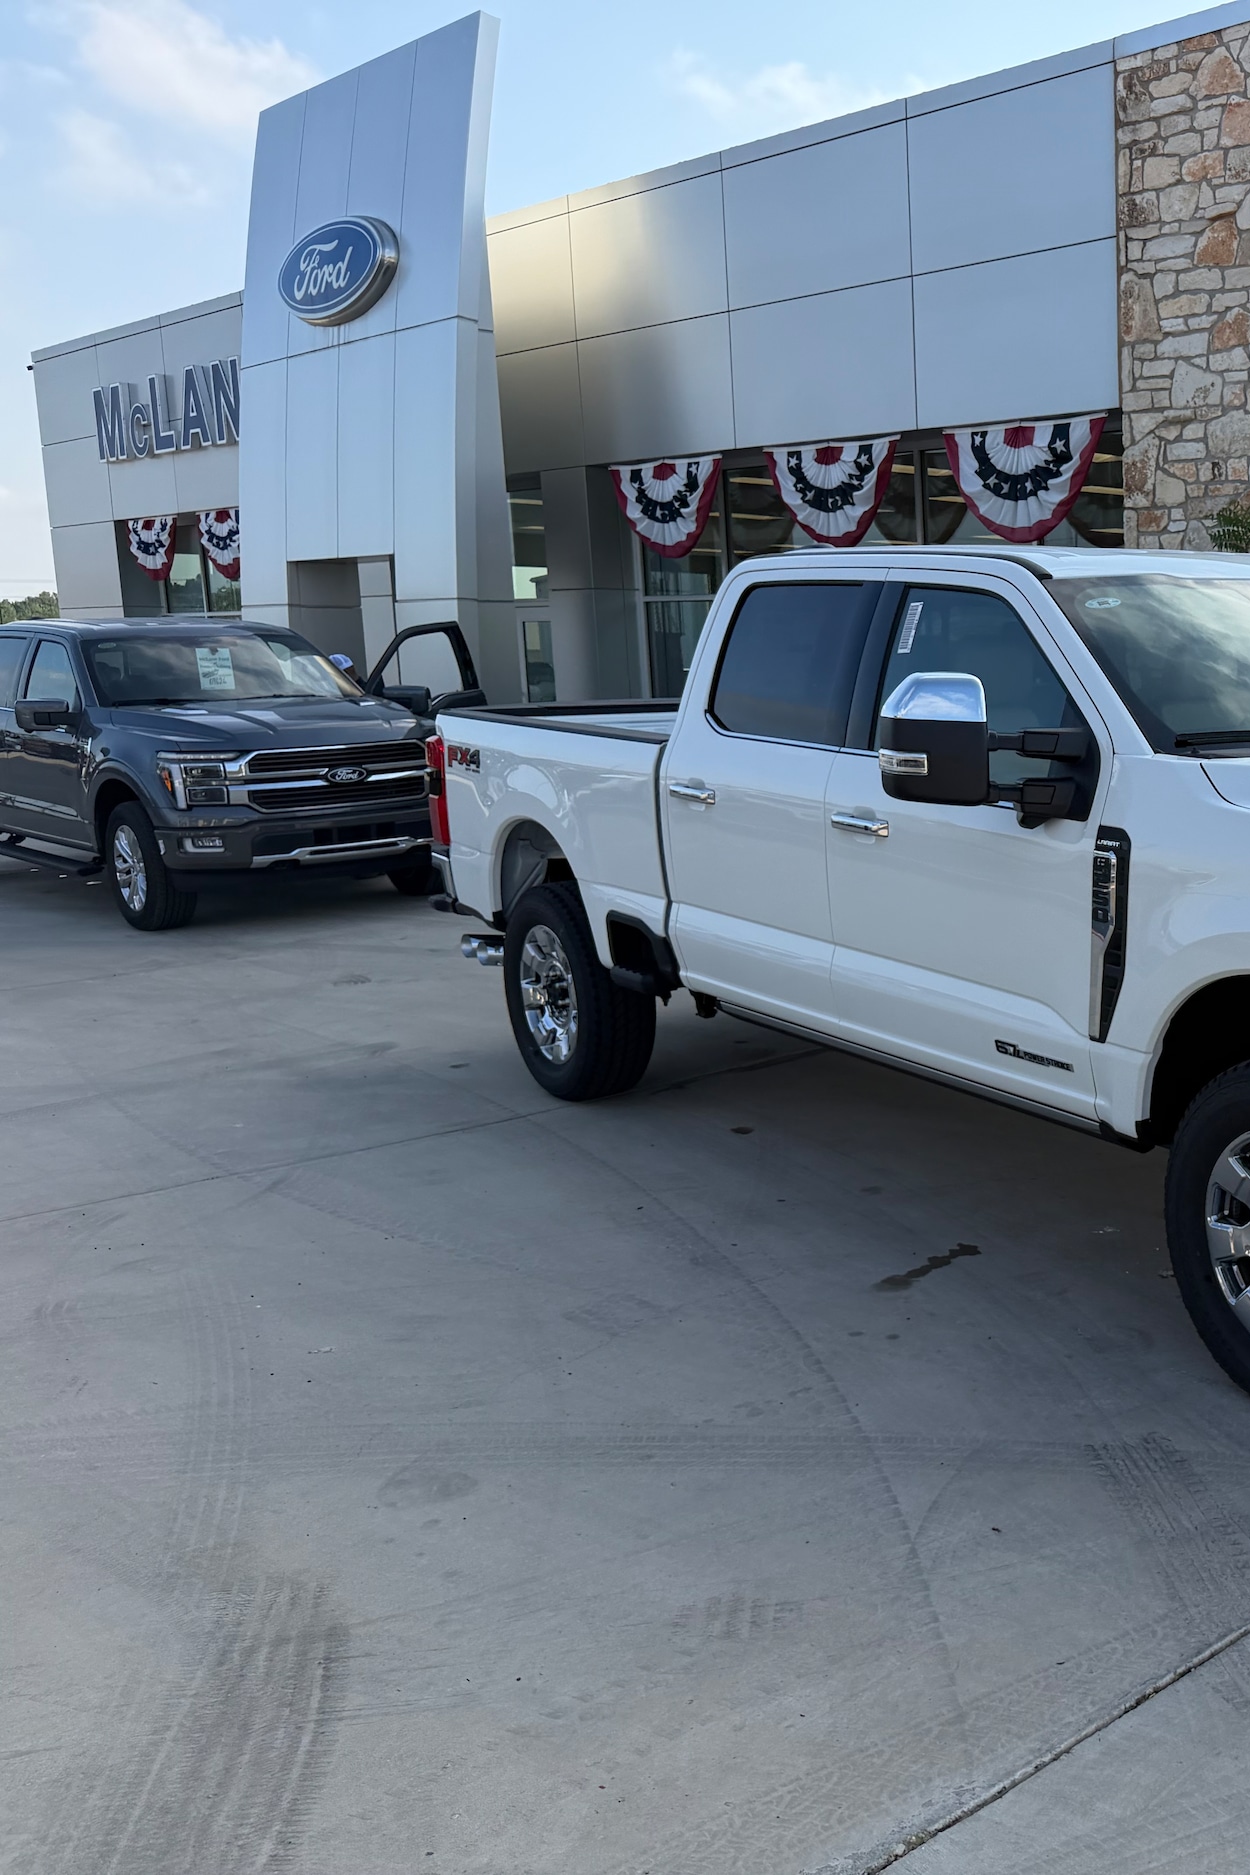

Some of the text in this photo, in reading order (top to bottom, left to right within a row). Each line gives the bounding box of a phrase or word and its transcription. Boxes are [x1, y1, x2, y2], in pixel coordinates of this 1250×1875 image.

[294, 239, 353, 301] Ford
[448, 745, 480, 768] FX4
[335, 769, 359, 780] Ford
